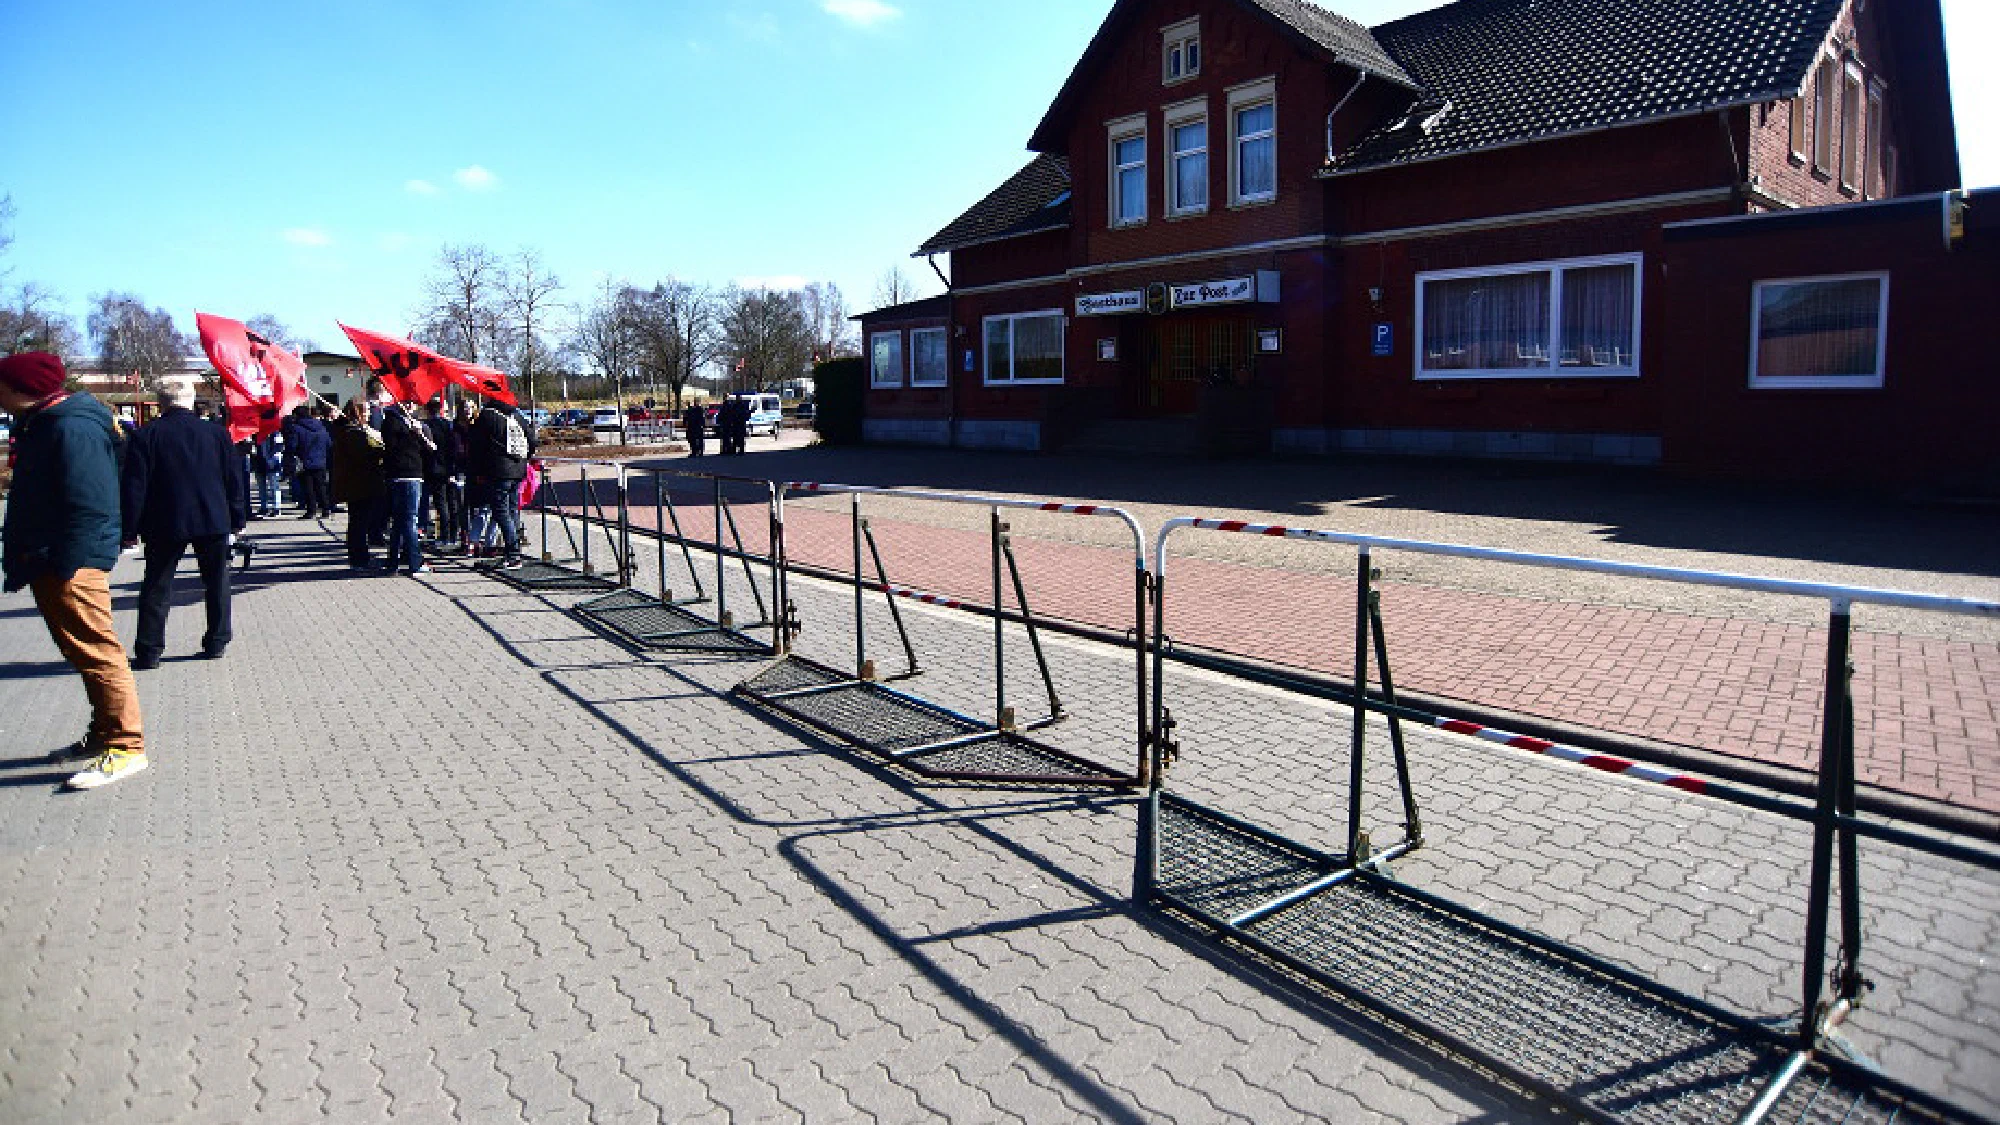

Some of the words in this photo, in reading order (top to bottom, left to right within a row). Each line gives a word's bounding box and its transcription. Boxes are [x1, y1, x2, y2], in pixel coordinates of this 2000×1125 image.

[1175, 288, 1196, 305] Zur
[1199, 284, 1228, 301] Post
[1377, 325, 1389, 342] P
